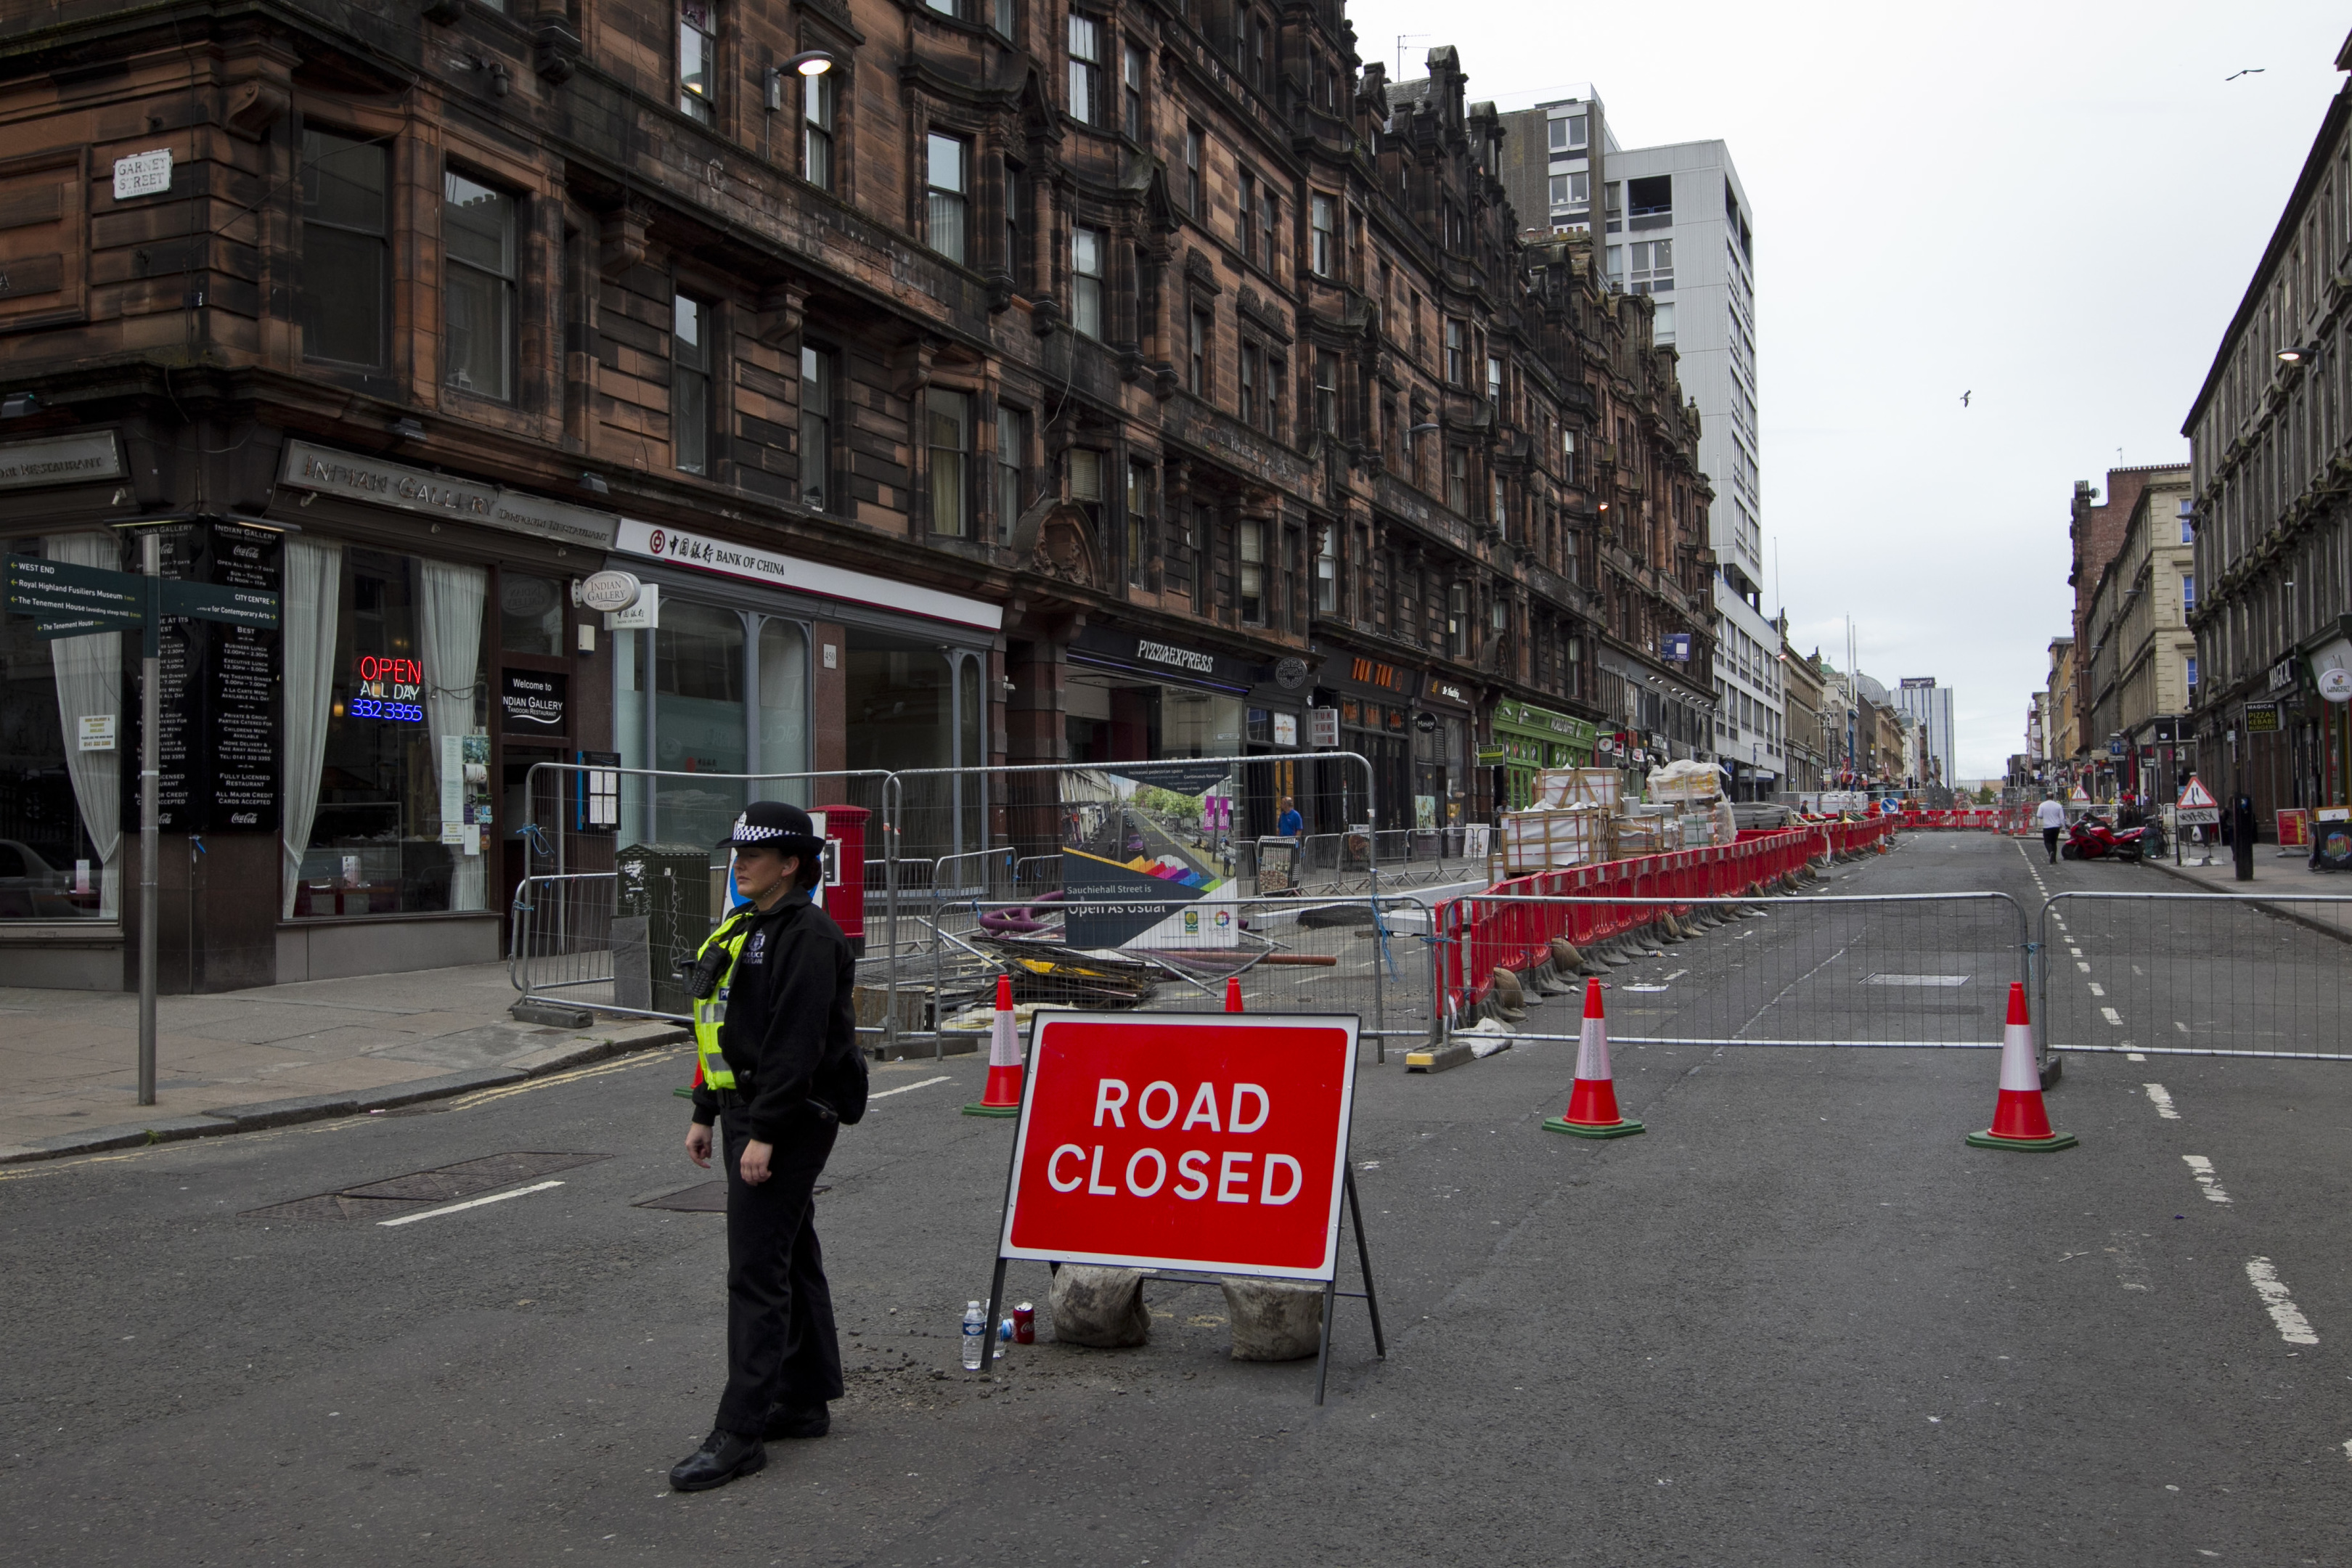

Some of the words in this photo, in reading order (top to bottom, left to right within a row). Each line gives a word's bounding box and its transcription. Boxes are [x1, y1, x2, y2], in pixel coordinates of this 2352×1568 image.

[118, 158, 168, 176] GARNET
[119, 173, 164, 190] STREET
[20, 457, 102, 475] RESTAURANT
[305, 454, 388, 493] INDIAN
[499, 507, 546, 528] TANDOORI
[548, 520, 609, 541] RESTAURANT
[215, 525, 242, 535] INDIAN
[245, 529, 277, 540] GALLERY
[19, 563, 38, 572] WEST
[41, 565, 54, 573] END
[716, 550, 742, 565] BANK
[743, 556, 755, 568] OF
[756, 559, 785, 576] CHINA
[19, 579, 37, 589] Royal
[38, 582, 67, 592] Highland
[69, 587, 95, 596] Fusiliers
[97, 590, 123, 600] Museum
[591, 581, 621, 591] INDIAN
[18, 596, 30, 605] The
[33, 598, 64, 608] Tenement
[65, 603, 85, 611] House
[588, 590, 625, 601] GALLERY
[221, 607, 258, 618] Contemporary
[825, 651, 836, 662] 450
[360, 656, 422, 684] OPEN
[1352, 657, 1373, 682] TUK
[1375, 663, 1393, 687] TUK
[2269, 658, 2291, 693] MAGICAL
[360, 681, 388, 698] ALL
[393, 684, 420, 701] DAY
[513, 678, 543, 690] Welcome
[351, 698, 382, 719] 332
[384, 702, 422, 722] 3355
[528, 697, 563, 711] GALLERY
[1067, 884, 1115, 894] Sauchiehall
[1118, 884, 1143, 893] Street
[1093, 1079, 1269, 1132] ROAD
[1048, 1144, 1302, 1205] CLOSED
